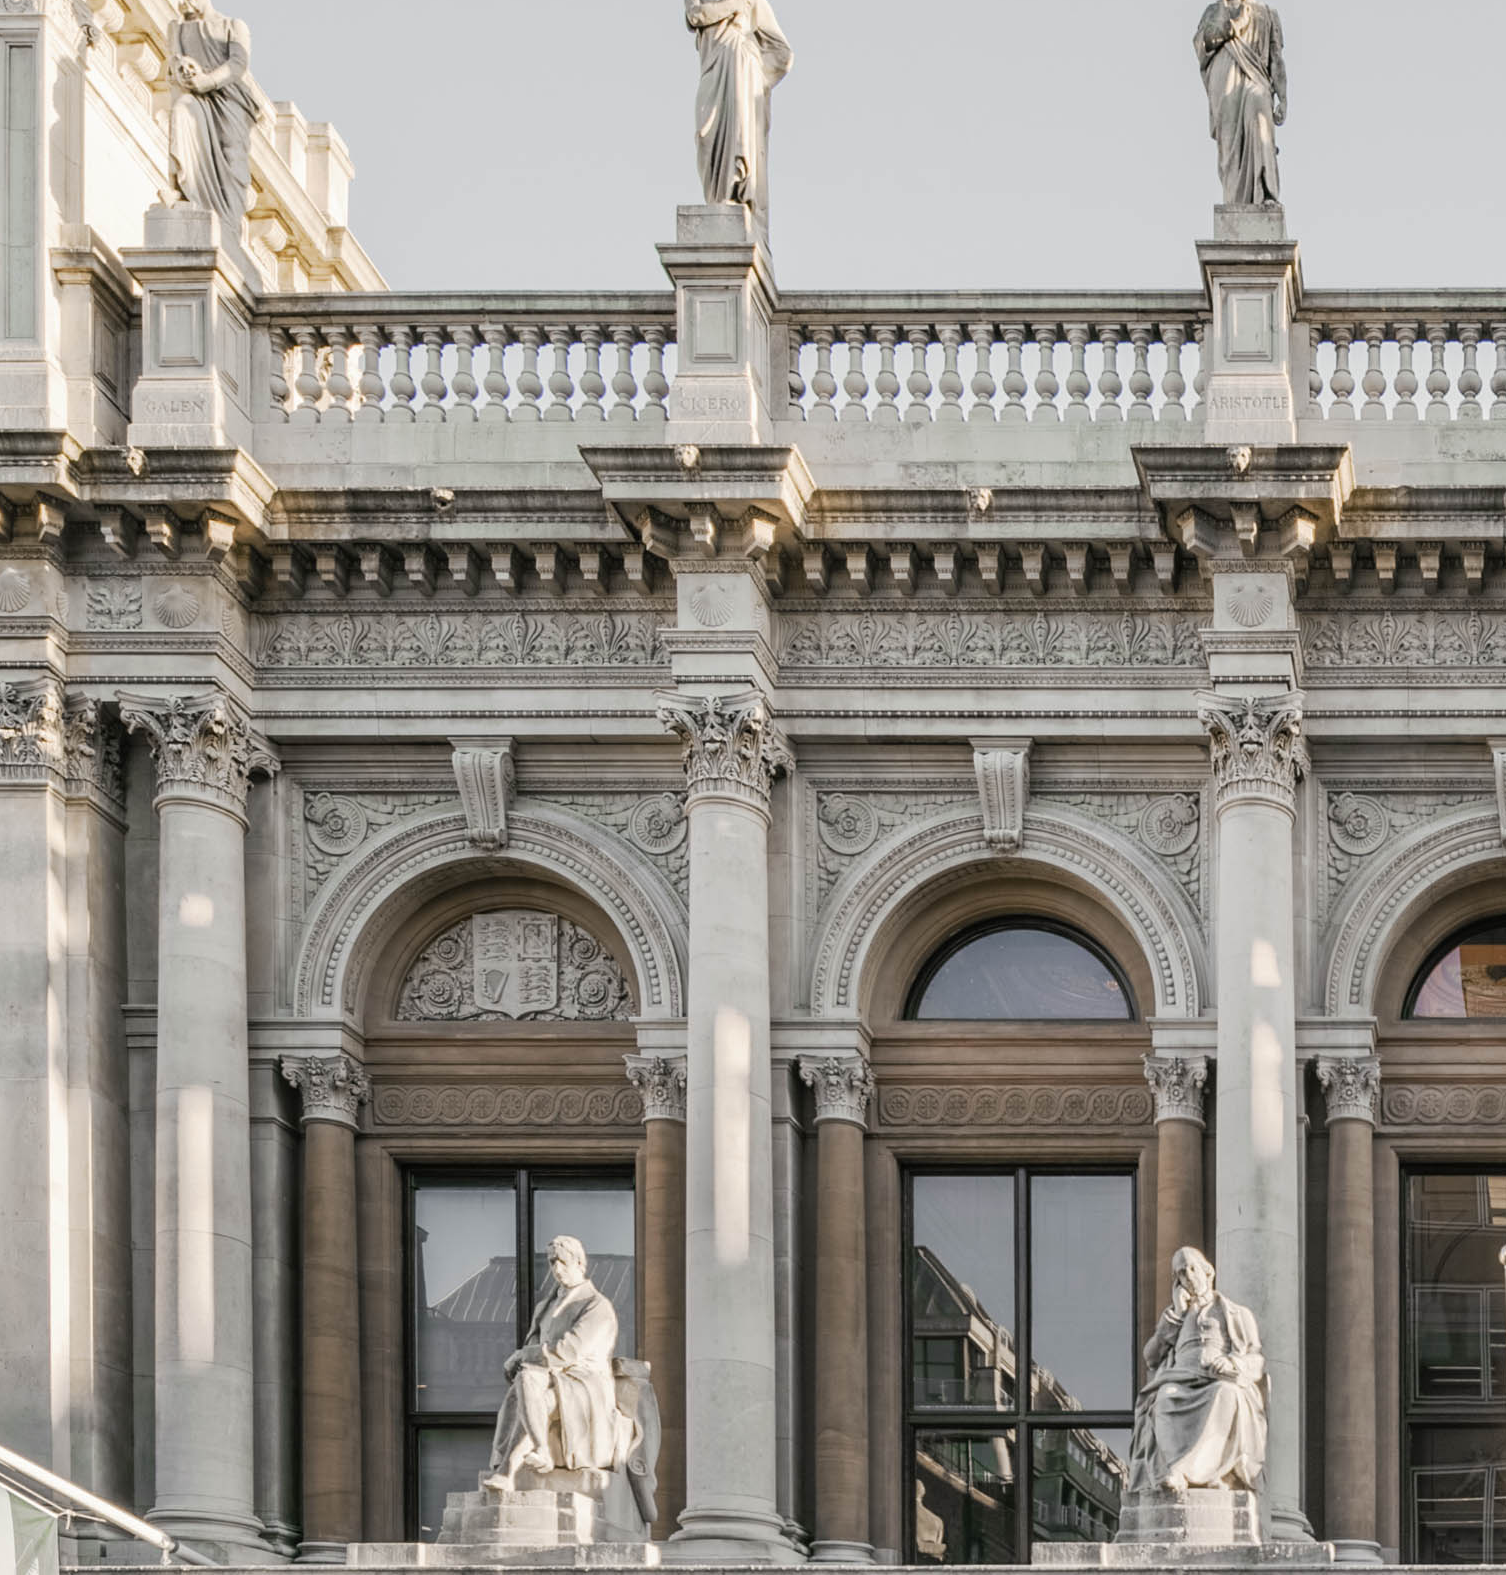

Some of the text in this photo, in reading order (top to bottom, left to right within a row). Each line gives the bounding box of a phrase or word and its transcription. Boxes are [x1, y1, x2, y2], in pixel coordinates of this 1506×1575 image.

[145, 400, 206, 414] GALEN
[679, 397, 741, 410] CICERO
[1208, 395, 1290, 410] ARISTOTLE
